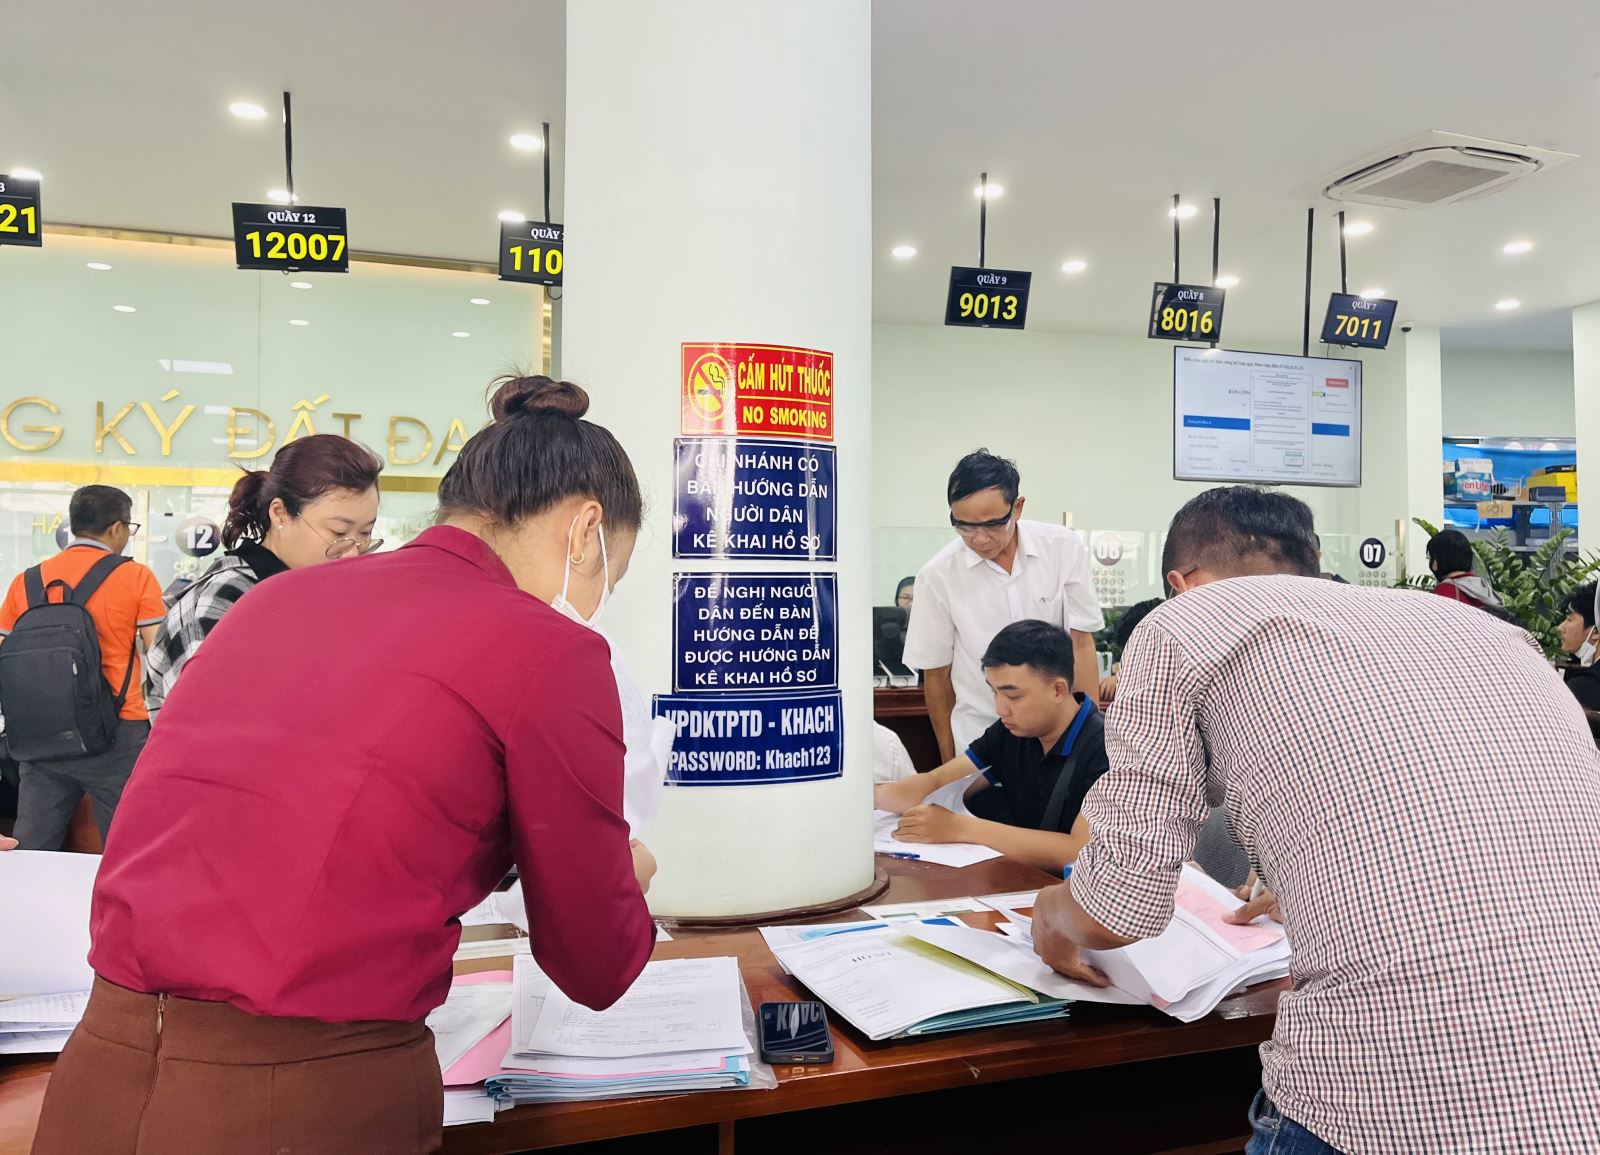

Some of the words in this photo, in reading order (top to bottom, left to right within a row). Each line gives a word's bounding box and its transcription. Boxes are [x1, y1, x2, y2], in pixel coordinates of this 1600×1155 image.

[267, 209, 301, 224] QUẦY
[302, 213, 316, 223] 12
[530, 227, 560, 240] QUẦY
[246, 230, 346, 261] 12007
[509, 245, 563, 275] 110
[1001, 276, 1007, 285] 9
[960, 292, 1018, 320] 9013
[1199, 292, 1205, 301] 8
[1372, 303, 1377, 311] 7
[1161, 306, 1213, 334] 8016
[1334, 314, 1382, 340] 7011
[737, 353, 765, 391] CẤM
[769, 357, 794, 393] HÚT
[797, 360, 831, 398] THUỐC
[95, 388, 196, 456] KÝ
[226, 393, 362, 459] ĐẤT
[743, 405, 764, 424] NO
[769, 407, 827, 429] SMOKING
[694, 453, 726, 469] CI
[734, 451, 793, 471] NHÁNH
[797, 454, 819, 473] CÓ
[732, 478, 794, 497] HƯỚNG
[798, 478, 828, 499] DẪN
[706, 504, 764, 523] NƯỜI
[769, 505, 803, 524] DÂN
[183, 525, 214, 550] 12
[693, 530, 718, 548] KÊ
[724, 533, 766, 549] KHAI
[772, 530, 796, 550] HỒ
[800, 534, 821, 551] SƠ
[1363, 543, 1382, 563] 07
[723, 586, 765, 601] NGHỊ
[770, 583, 817, 599] NGƯỜI
[698, 605, 734, 620] DÂN
[739, 602, 774, 620] ĐẾN
[779, 604, 811, 620] BÀN
[693, 626, 755, 642] HƯỚNG
[761, 623, 794, 641] DẪN
[684, 649, 734, 666] ĐƯỢC
[739, 647, 798, 663] HƯỚNG
[802, 644, 830, 661] DẪN
[695, 669, 718, 685] KÊ
[724, 672, 764, 685] KHAI
[769, 666, 793, 684] HỒ
[796, 668, 817, 683] SƠ
[781, 705, 835, 736] KHACH
[668, 750, 761, 772] PASSWORD:
[765, 745, 831, 770] Khach123
